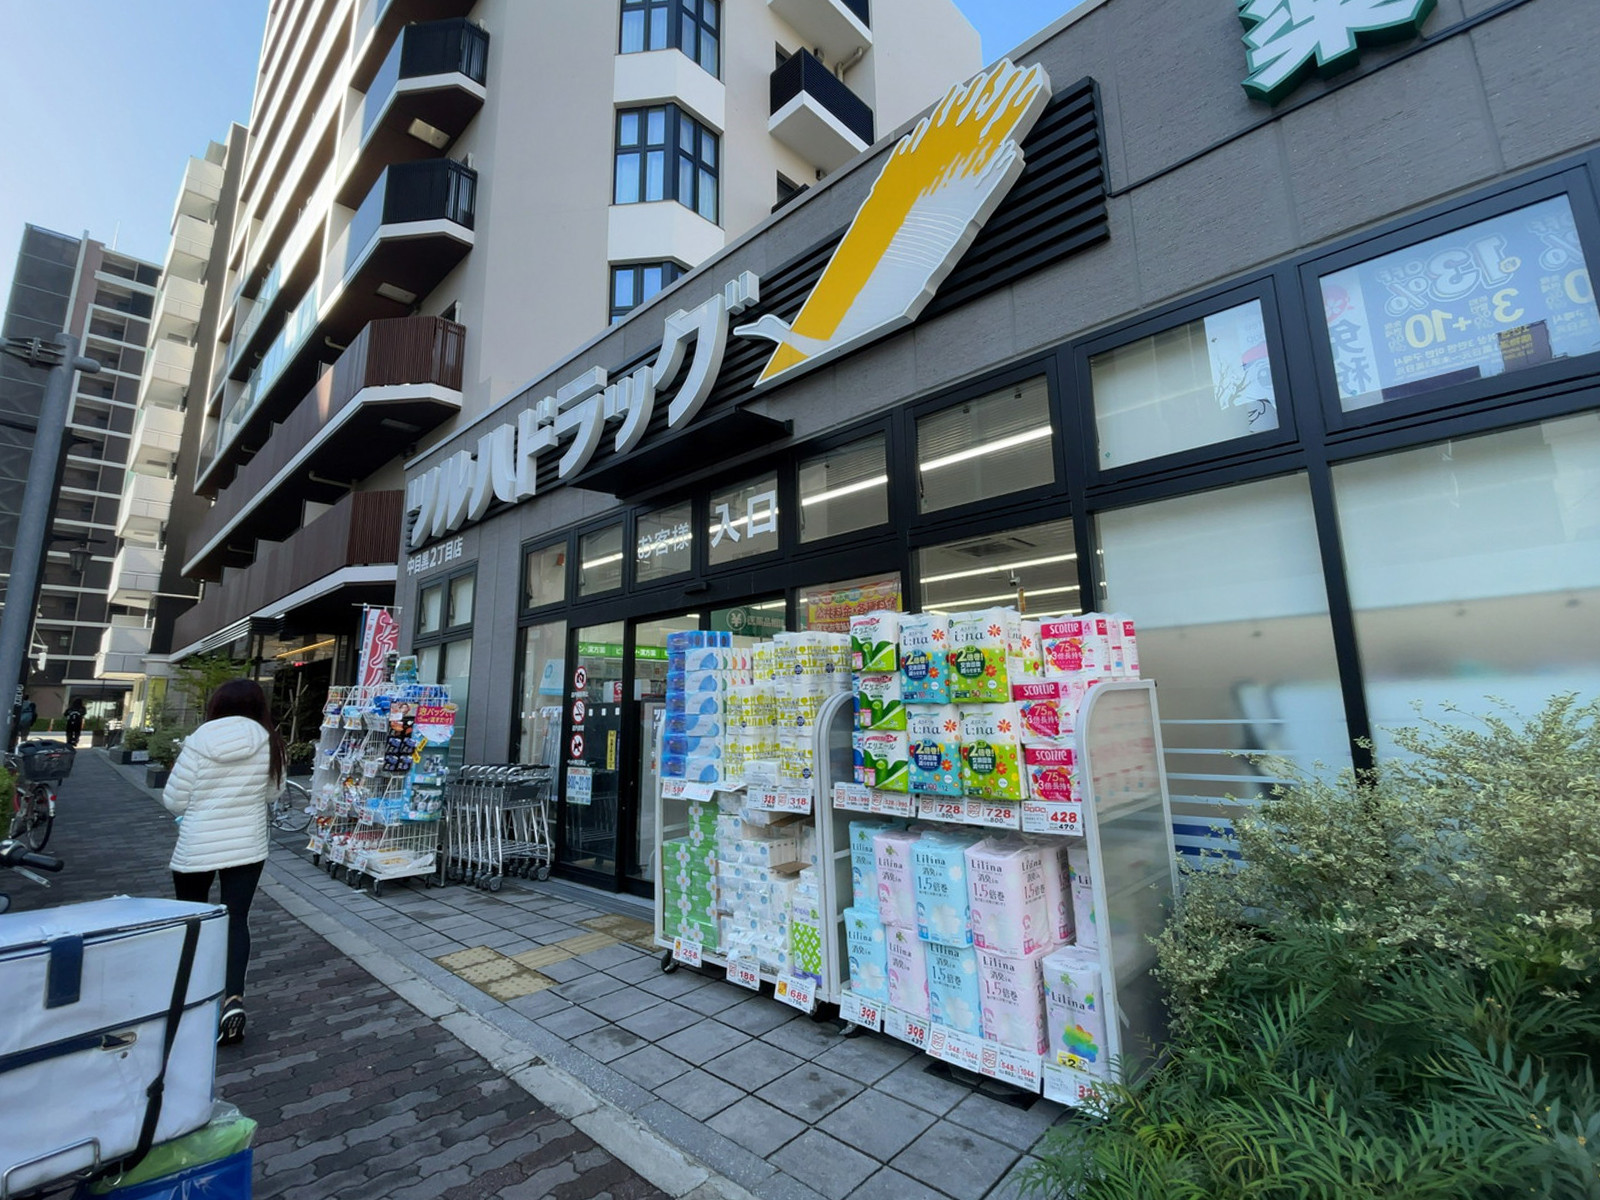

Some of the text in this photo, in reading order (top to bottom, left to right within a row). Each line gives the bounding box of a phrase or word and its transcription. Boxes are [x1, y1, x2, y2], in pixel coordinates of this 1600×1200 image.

[408, 270, 760, 548] ツルハドラッグ
[637, 489, 777, 559] お客様 入口
[407, 536, 463, 576] 中目黒2丁目店
[1050, 812, 1077, 823] 428
